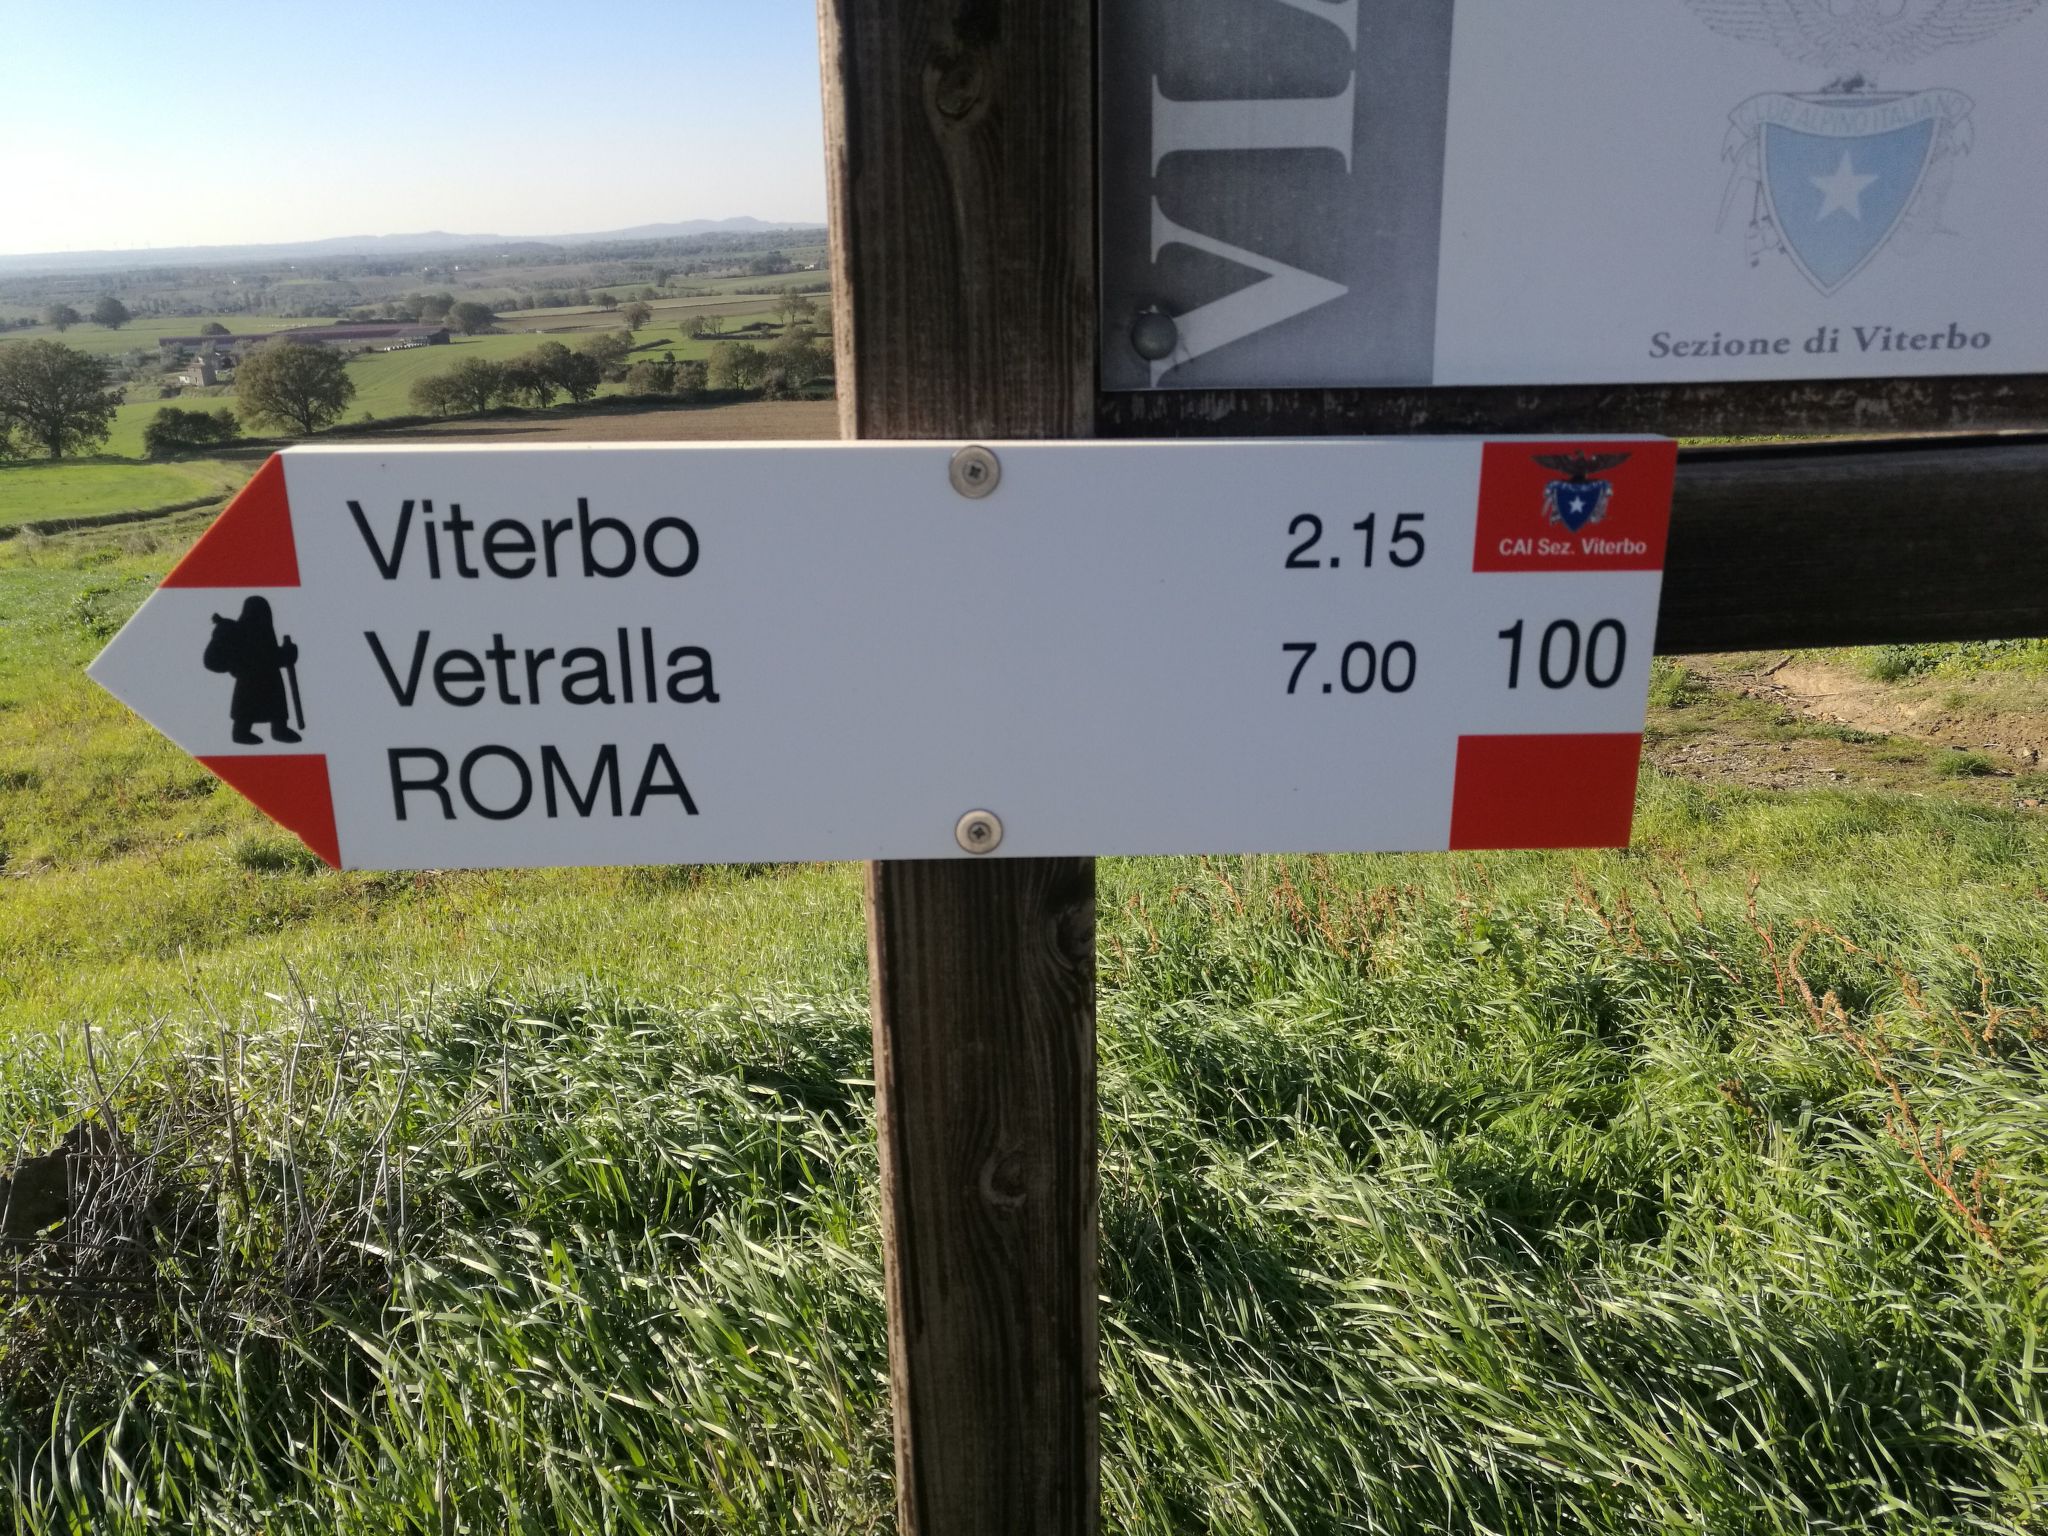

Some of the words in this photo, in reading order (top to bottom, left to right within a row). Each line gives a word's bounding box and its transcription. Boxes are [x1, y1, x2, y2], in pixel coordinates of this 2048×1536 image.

[1150, 0, 1358, 389] VI
[1648, 331, 1792, 359] Sezione
[1802, 325, 1841, 354] di
[1852, 322, 1993, 352] Viterbo
[345, 496, 700, 581] Viterbo
[1284, 512, 1426, 570] 2.15
[1499, 538, 1533, 556] CAI
[1537, 537, 1576, 556] Sez.
[1581, 537, 1648, 555] Viterbo
[363, 627, 721, 708] Vetralla
[1281, 640, 1418, 695] 7.00
[1497, 618, 1628, 690] 100
[387, 743, 700, 821] ROMA
